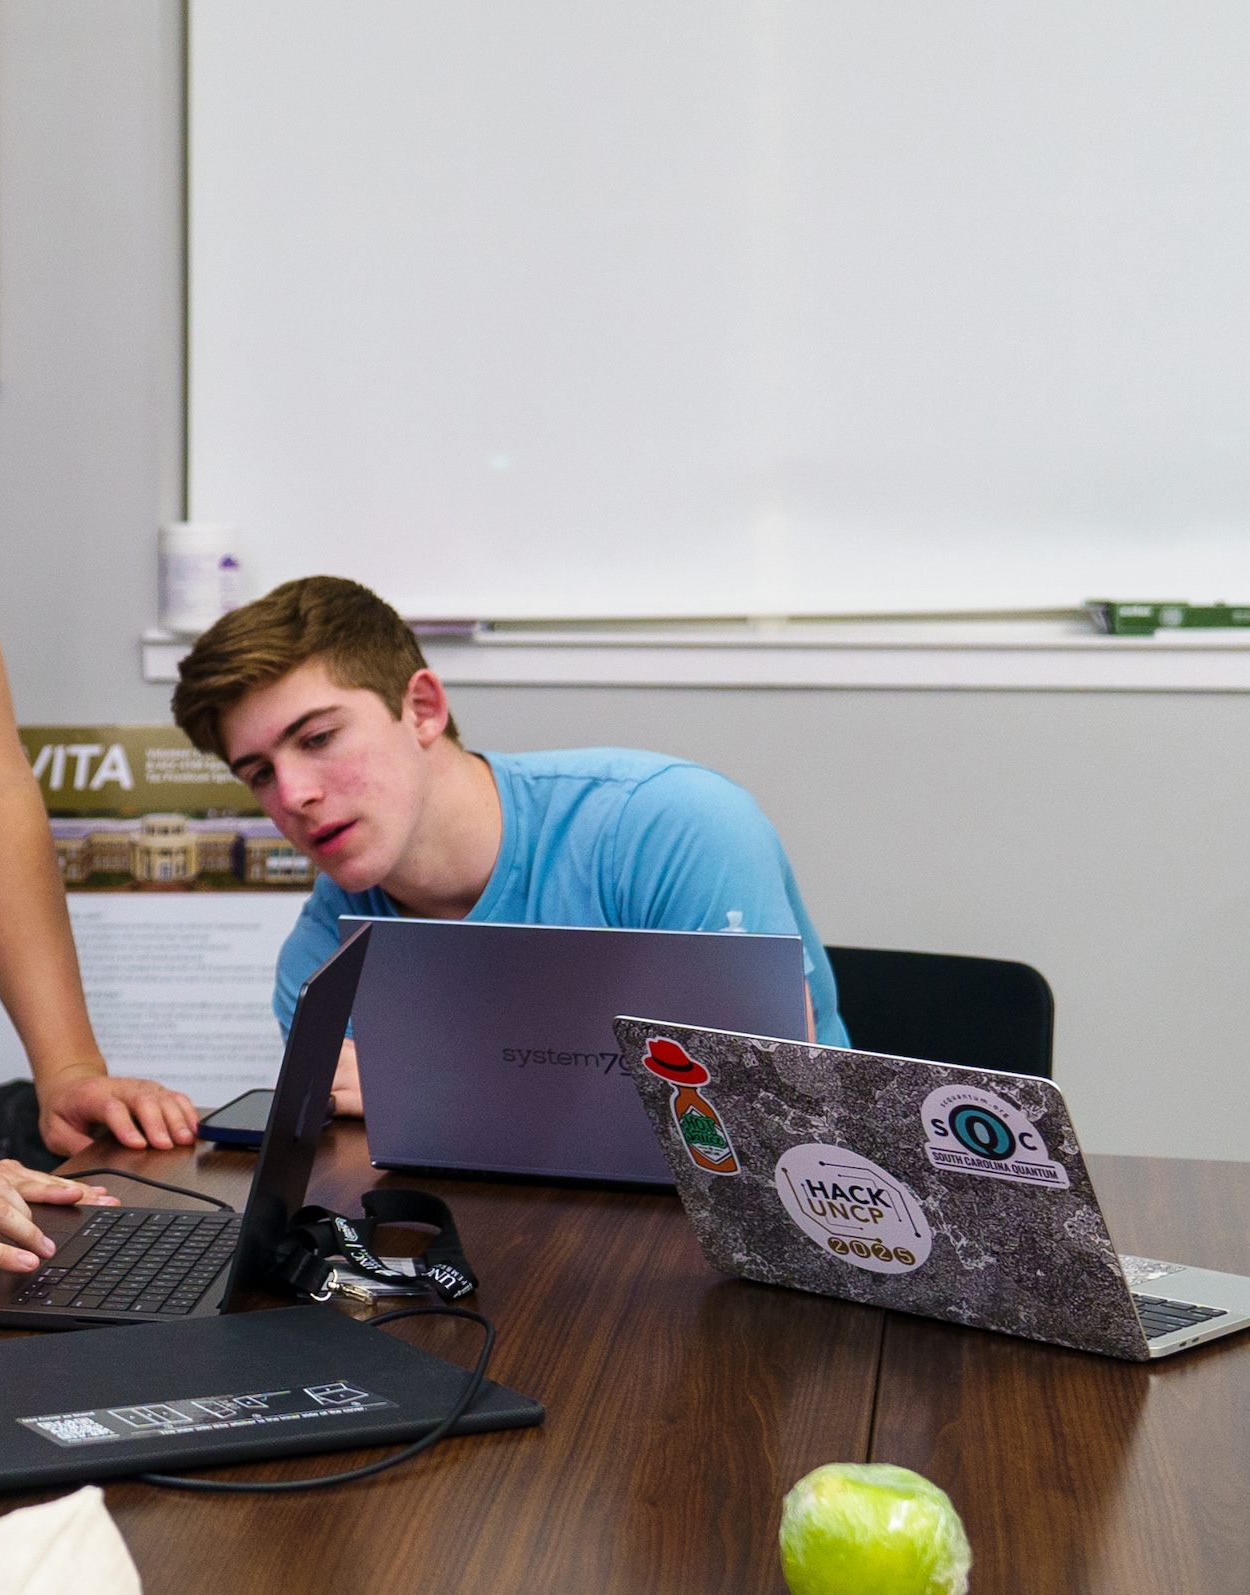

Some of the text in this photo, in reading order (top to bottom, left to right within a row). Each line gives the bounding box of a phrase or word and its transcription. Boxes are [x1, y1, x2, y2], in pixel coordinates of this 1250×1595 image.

[939, 1093, 1010, 1119] scquantum.org
[684, 1114, 716, 1134] HOT
[932, 1151, 1059, 1180] SOUTH CAROLINA QUANTUM
[804, 1178, 892, 1209] HACK
[807, 1197, 885, 1225] UNCP
[829, 1238, 916, 1266] 2025
